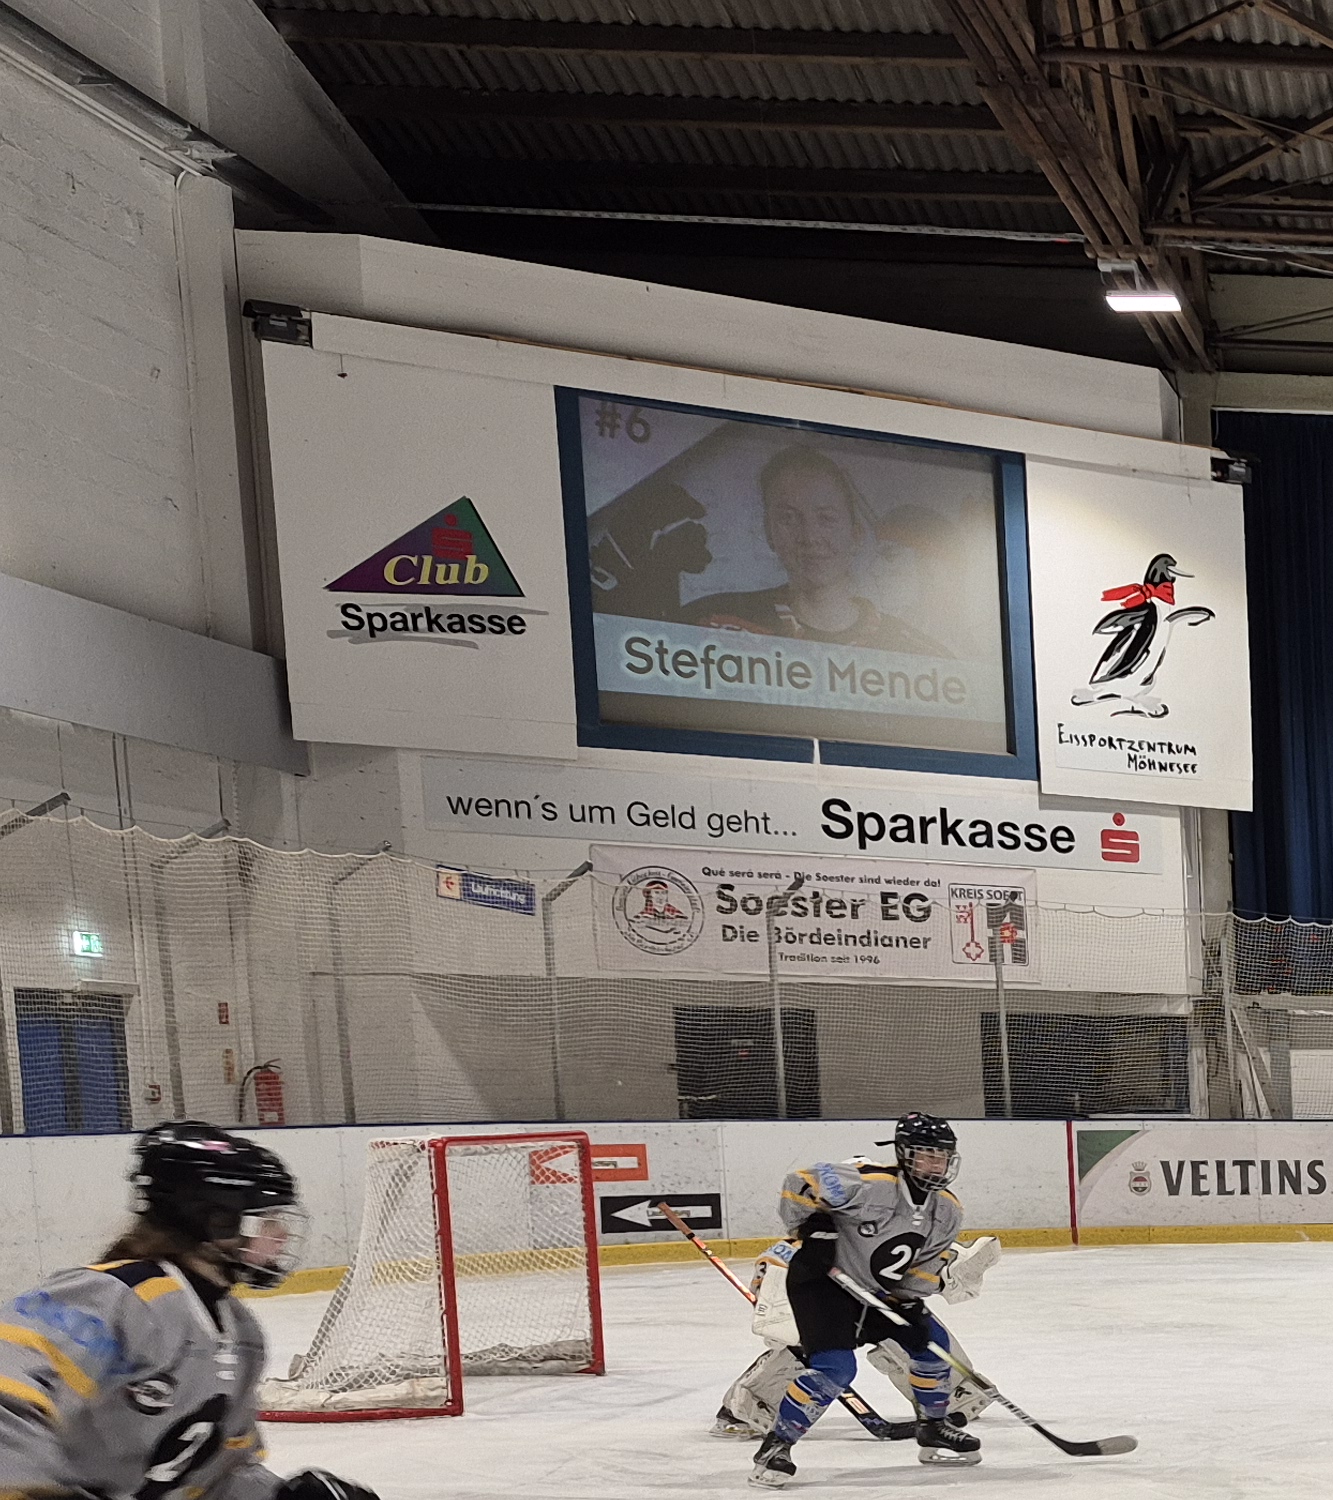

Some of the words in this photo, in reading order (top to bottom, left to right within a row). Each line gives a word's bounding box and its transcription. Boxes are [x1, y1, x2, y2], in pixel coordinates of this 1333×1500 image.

[383, 554, 490, 587] Club
[340, 603, 526, 637] Sparkasse
[624, 637, 812, 691] Stefanie
[829, 658, 967, 705] Mende
[569, 804, 616, 826] um
[626, 800, 696, 831] Geld
[707, 807, 798, 838] geht...
[820, 797, 1077, 855] Sparkasse
[815, 872, 857, 885] Soester
[859, 873, 881, 886] sind
[884, 875, 921, 888] wieder
[923, 877, 942, 889] da!
[951, 888, 984, 900] KREIS
[986, 889, 1023, 902] SOET
[880, 890, 932, 923] EG
[721, 924, 760, 943] Die
[1159, 1159, 1328, 1196] VELTINS
